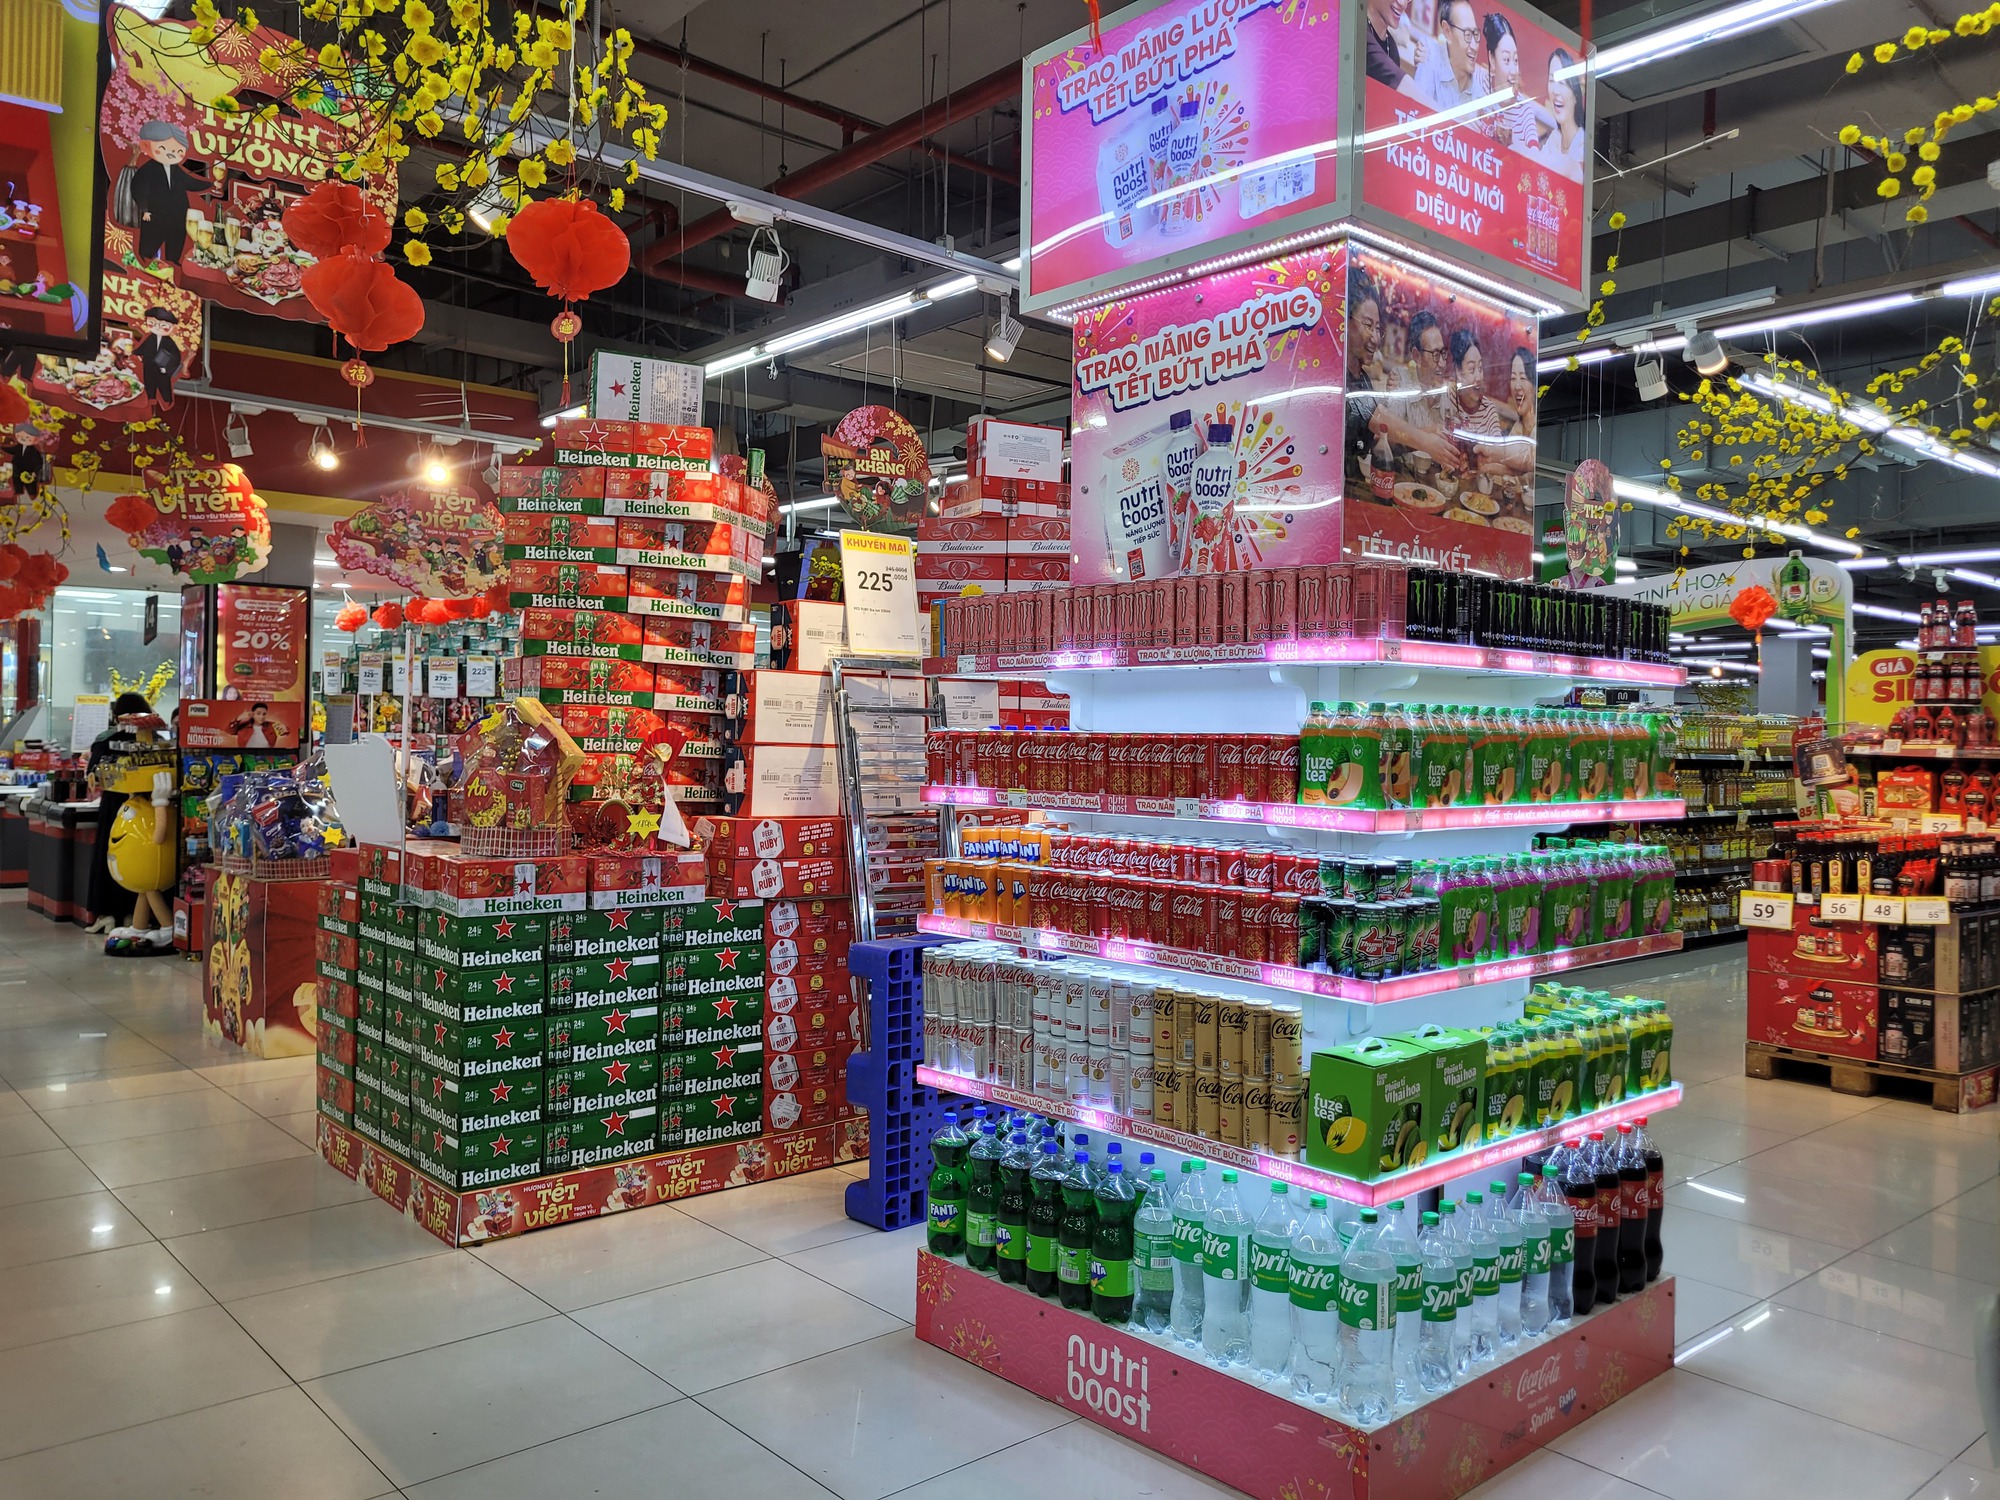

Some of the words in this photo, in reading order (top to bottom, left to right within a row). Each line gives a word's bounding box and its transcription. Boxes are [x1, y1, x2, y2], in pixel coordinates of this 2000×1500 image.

[1061, 61, 1115, 105] TRAO
[1120, 23, 1184, 74] NĂNG
[1094, 74, 1128, 116] TẾT
[1136, 53, 1178, 95] BỨT
[1184, 20, 1232, 69] PHÁ
[1171, 133, 1199, 151] nutri
[1170, 145, 1198, 162] boost
[1472, 147, 1503, 179] KẾT
[1113, 157, 1146, 188] nutri
[1386, 141, 1430, 180] KHỞI
[1435, 166, 1469, 198] ĐẦU
[1474, 181, 1504, 214] MỚI
[1114, 172, 1148, 200] boost
[1416, 191, 1456, 224] DIỆU
[1460, 207, 1482, 236] KỲ
[1081, 350, 1138, 385] TRAO
[1144, 326, 1211, 364] NĂNG
[1219, 294, 1316, 341] LƯỢNG,
[348, 363, 367, 383] 福
[1114, 370, 1151, 402] TẾT
[1158, 355, 1203, 391] BỨT
[1211, 336, 1262, 374] PHÁ
[629, 361, 643, 422] Heineken
[557, 449, 631, 468] Heineken
[636, 454, 709, 473] Heineken
[1166, 443, 1198, 466] nutri
[1196, 465, 1233, 482] nutri
[1120, 480, 1161, 511] nutri
[1195, 477, 1231, 498] boost
[517, 498, 583, 512] Heineken
[624, 500, 690, 517] Heineken
[1121, 499, 1163, 530] boost
[524, 546, 594, 561] Heineken
[846, 537, 887, 551] KHUYẾN
[888, 543, 907, 554] MẠI
[938, 541, 984, 552] Budweiser
[637, 551, 707, 568] Heineken
[1440, 544, 1471, 573] KẾT
[857, 570, 893, 592] 225
[1634, 583, 1680, 601] TINH
[1684, 571, 1730, 594] HOA
[531, 594, 606, 610] Heineken
[650, 599, 721, 617] Heineken
[232, 630, 291, 651] 20%
[546, 640, 620, 657] Heineken
[664, 648, 733, 665] Heineken
[998, 656, 1015, 666] TRAO
[1875, 658, 1906, 674] GIÁ
[562, 689, 633, 705] Heineken
[1305, 752, 1334, 771] fuze
[1428, 761, 1446, 778] fuze
[1305, 767, 1327, 783] tea
[1136, 800, 1156, 811] TRAO
[761, 829, 774, 838] BEER
[1932, 822, 1948, 832] 52
[759, 837, 779, 852] RUBY
[464, 868, 490, 877] 2026
[758, 876, 778, 891] RUBY
[484, 897, 563, 914] Heineken
[616, 889, 685, 906] Heineken
[1753, 903, 1775, 918] 59
[1831, 903, 1847, 914] 56
[1874, 904, 1891, 916] 48
[574, 932, 661, 957] Heineken
[684, 923, 764, 947] Heineken
[462, 945, 544, 968] Heineken
[1134, 950, 1155, 961] TRAO
[1156, 953, 1179, 965] NĂNG
[1210, 957, 1225, 971] TẾT
[1225, 962, 1243, 974] BỨT
[1243, 965, 1261, 978] PHÁ
[688, 972, 765, 995] Heineken
[574, 982, 660, 1009] Heineken
[463, 998, 544, 1024] Heineken
[684, 1020, 763, 1046] Heineken
[572, 1034, 658, 1062] Heineken
[463, 1052, 543, 1078] Heineken
[684, 1068, 763, 1096] Heineken
[1539, 1076, 1556, 1093] fuze
[572, 1084, 658, 1115] Heineken
[1313, 1093, 1343, 1114] fuze
[461, 1105, 542, 1133] Heineken
[1314, 1107, 1335, 1122] tea
[684, 1115, 763, 1145] Heineken
[570, 1133, 656, 1166] Heineken
[1133, 1124, 1153, 1135] TRAO
[1154, 1129, 1176, 1143] NĂNG
[1207, 1142, 1222, 1156] TẾT
[1223, 1148, 1239, 1160] BỨT
[1241, 1154, 1258, 1168] PHÁ
[461, 1159, 541, 1188] Heineken
[930, 1203, 959, 1217] FANTA
[1203, 1229, 1231, 1259] rite
[1290, 1266, 1335, 1300] prite
[1067, 1334, 1149, 1393] nutri
[1067, 1359, 1151, 1432] boost
[1529, 1405, 1556, 1434] Sprite
